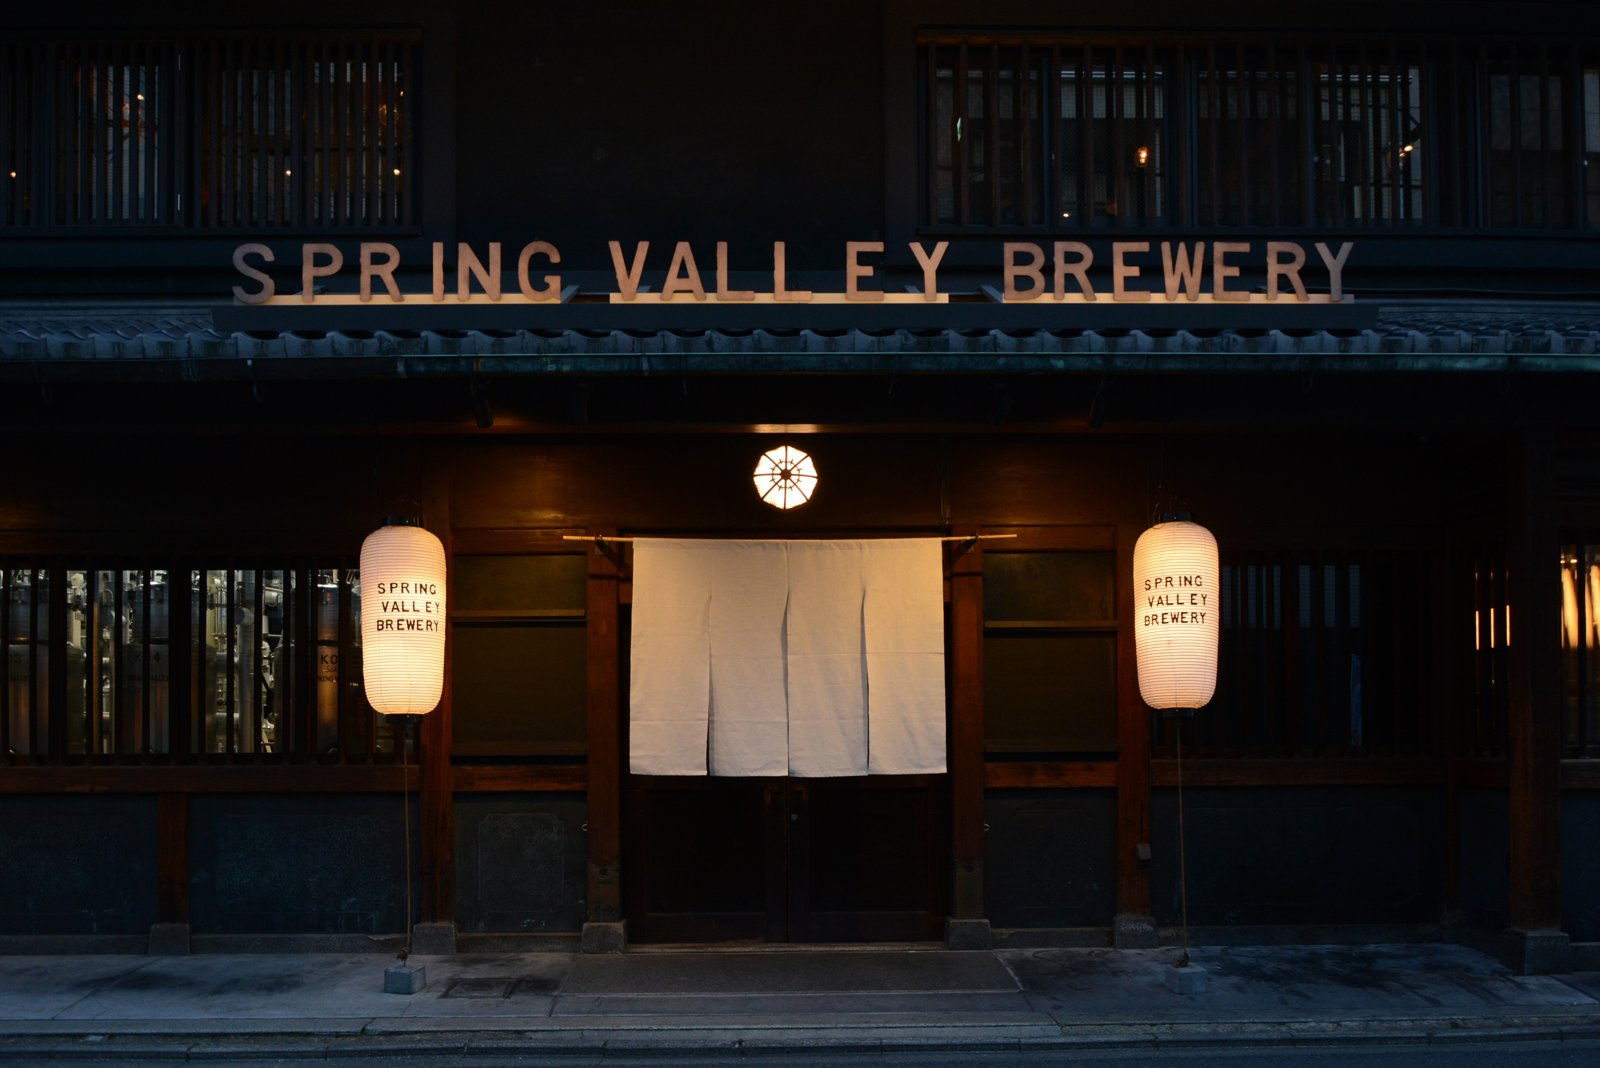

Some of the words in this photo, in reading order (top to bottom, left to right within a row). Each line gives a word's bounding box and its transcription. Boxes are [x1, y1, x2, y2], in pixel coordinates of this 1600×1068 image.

[231, 240, 562, 303] SPRING
[608, 240, 949, 301] VALLEY
[1003, 241, 1354, 302] BREWERY
[377, 582, 437, 595] SPRING
[1144, 575, 1203, 591] SPRING
[381, 600, 440, 613] VALLEY
[1147, 593, 1208, 608] VALLEY
[376, 618, 439, 632] BREWERY
[1144, 611, 1207, 627] BREWERY
